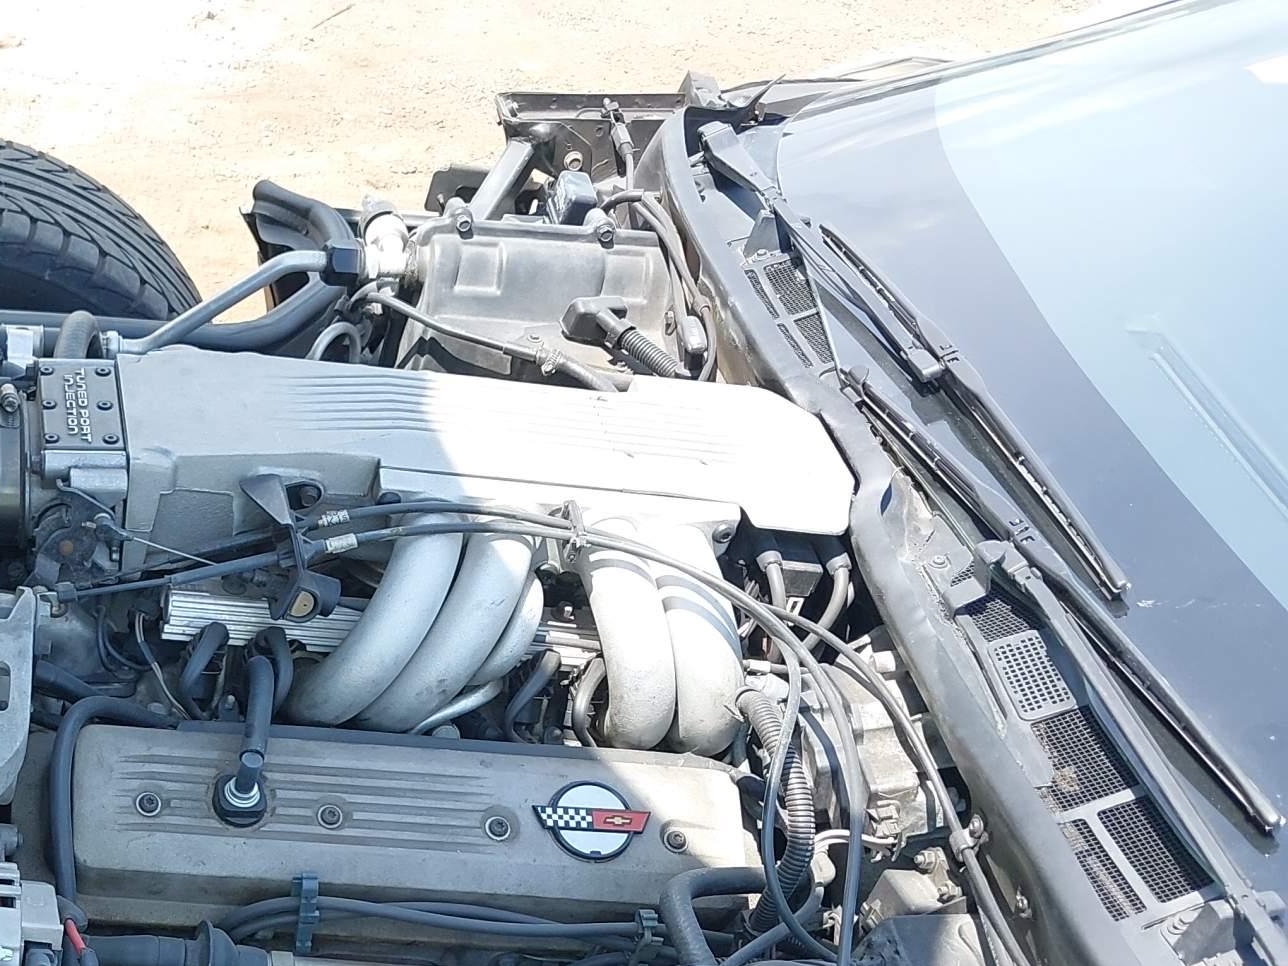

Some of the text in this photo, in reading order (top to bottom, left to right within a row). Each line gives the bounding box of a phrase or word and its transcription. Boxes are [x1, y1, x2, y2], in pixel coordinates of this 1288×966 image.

[63, 374, 79, 435] INJECTION
[74, 368, 92, 442] TUNED PORT
